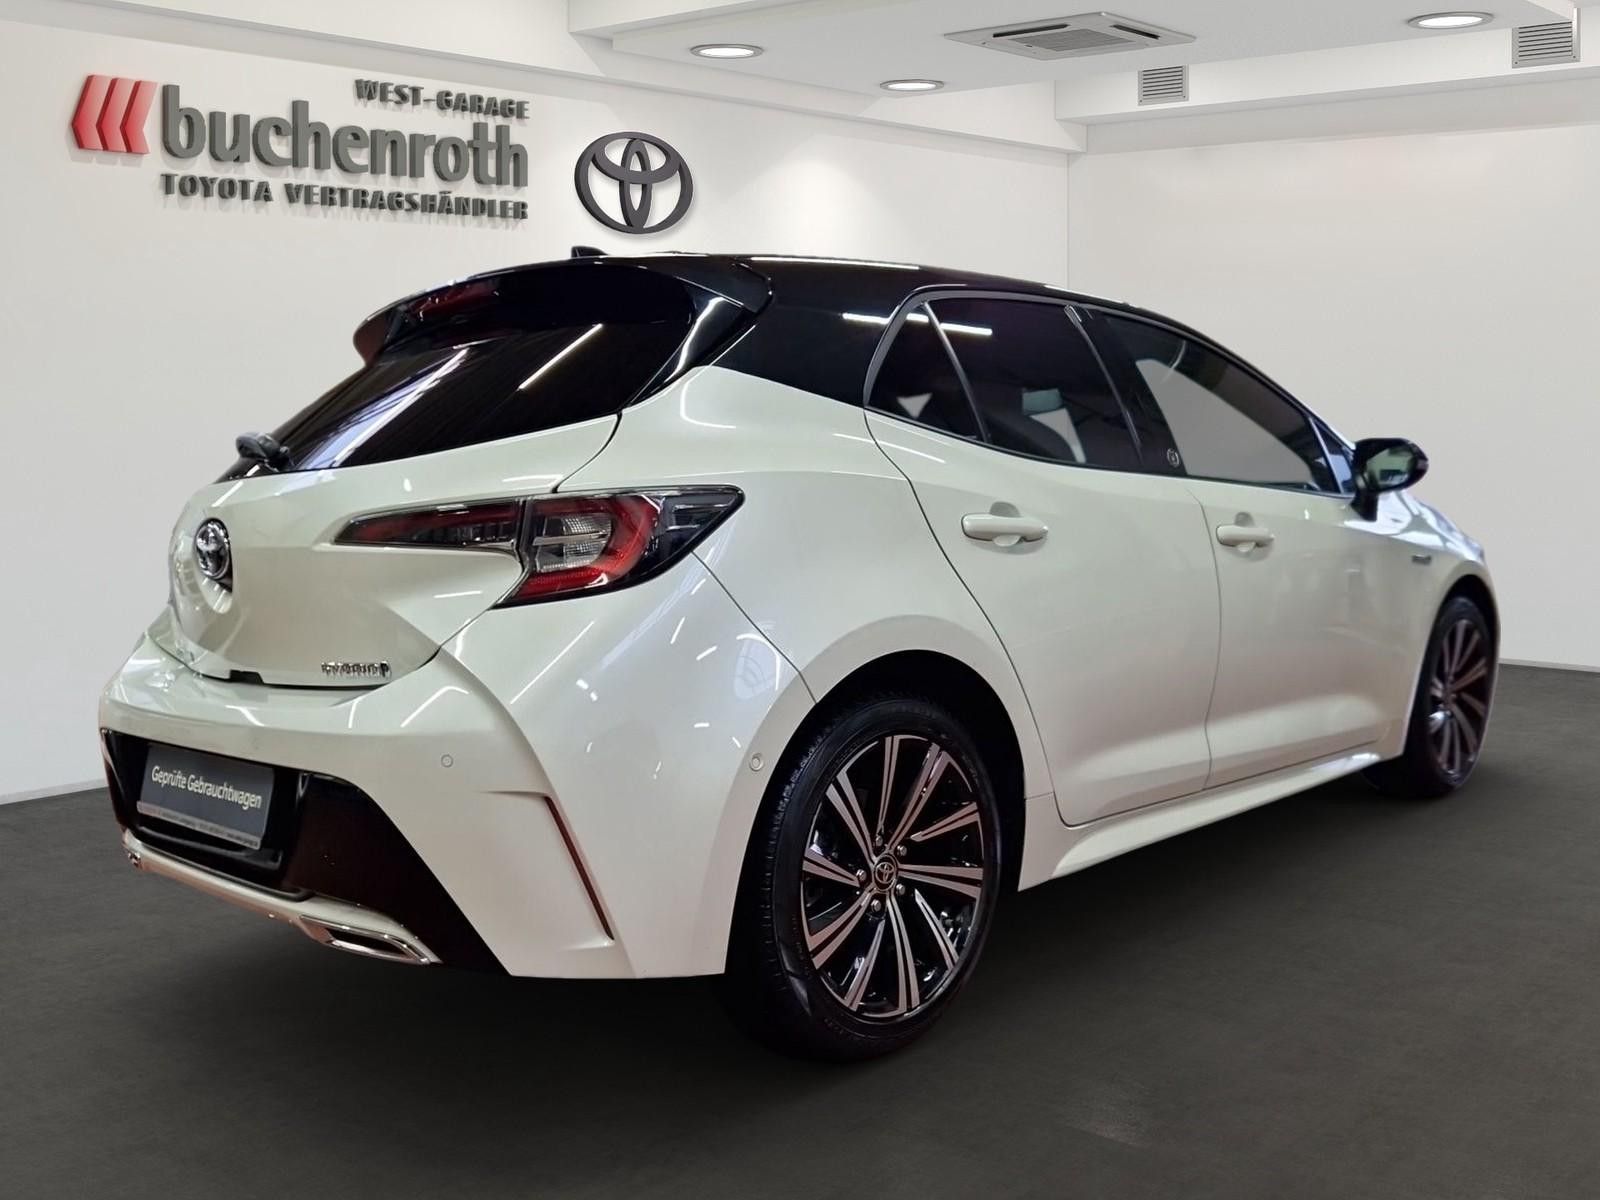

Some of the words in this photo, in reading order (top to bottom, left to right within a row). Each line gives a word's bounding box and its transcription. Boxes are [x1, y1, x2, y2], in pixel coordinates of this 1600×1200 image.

[354, 78, 531, 119] WEST-GARAGE
[162, 84, 528, 187] buchenroth
[160, 173, 273, 202] TOYOTA
[284, 183, 528, 219] VERTRAGSHÄNDLER
[151, 765, 187, 788] Geprüfte
[187, 774, 262, 810] Gebrauchtwagen
